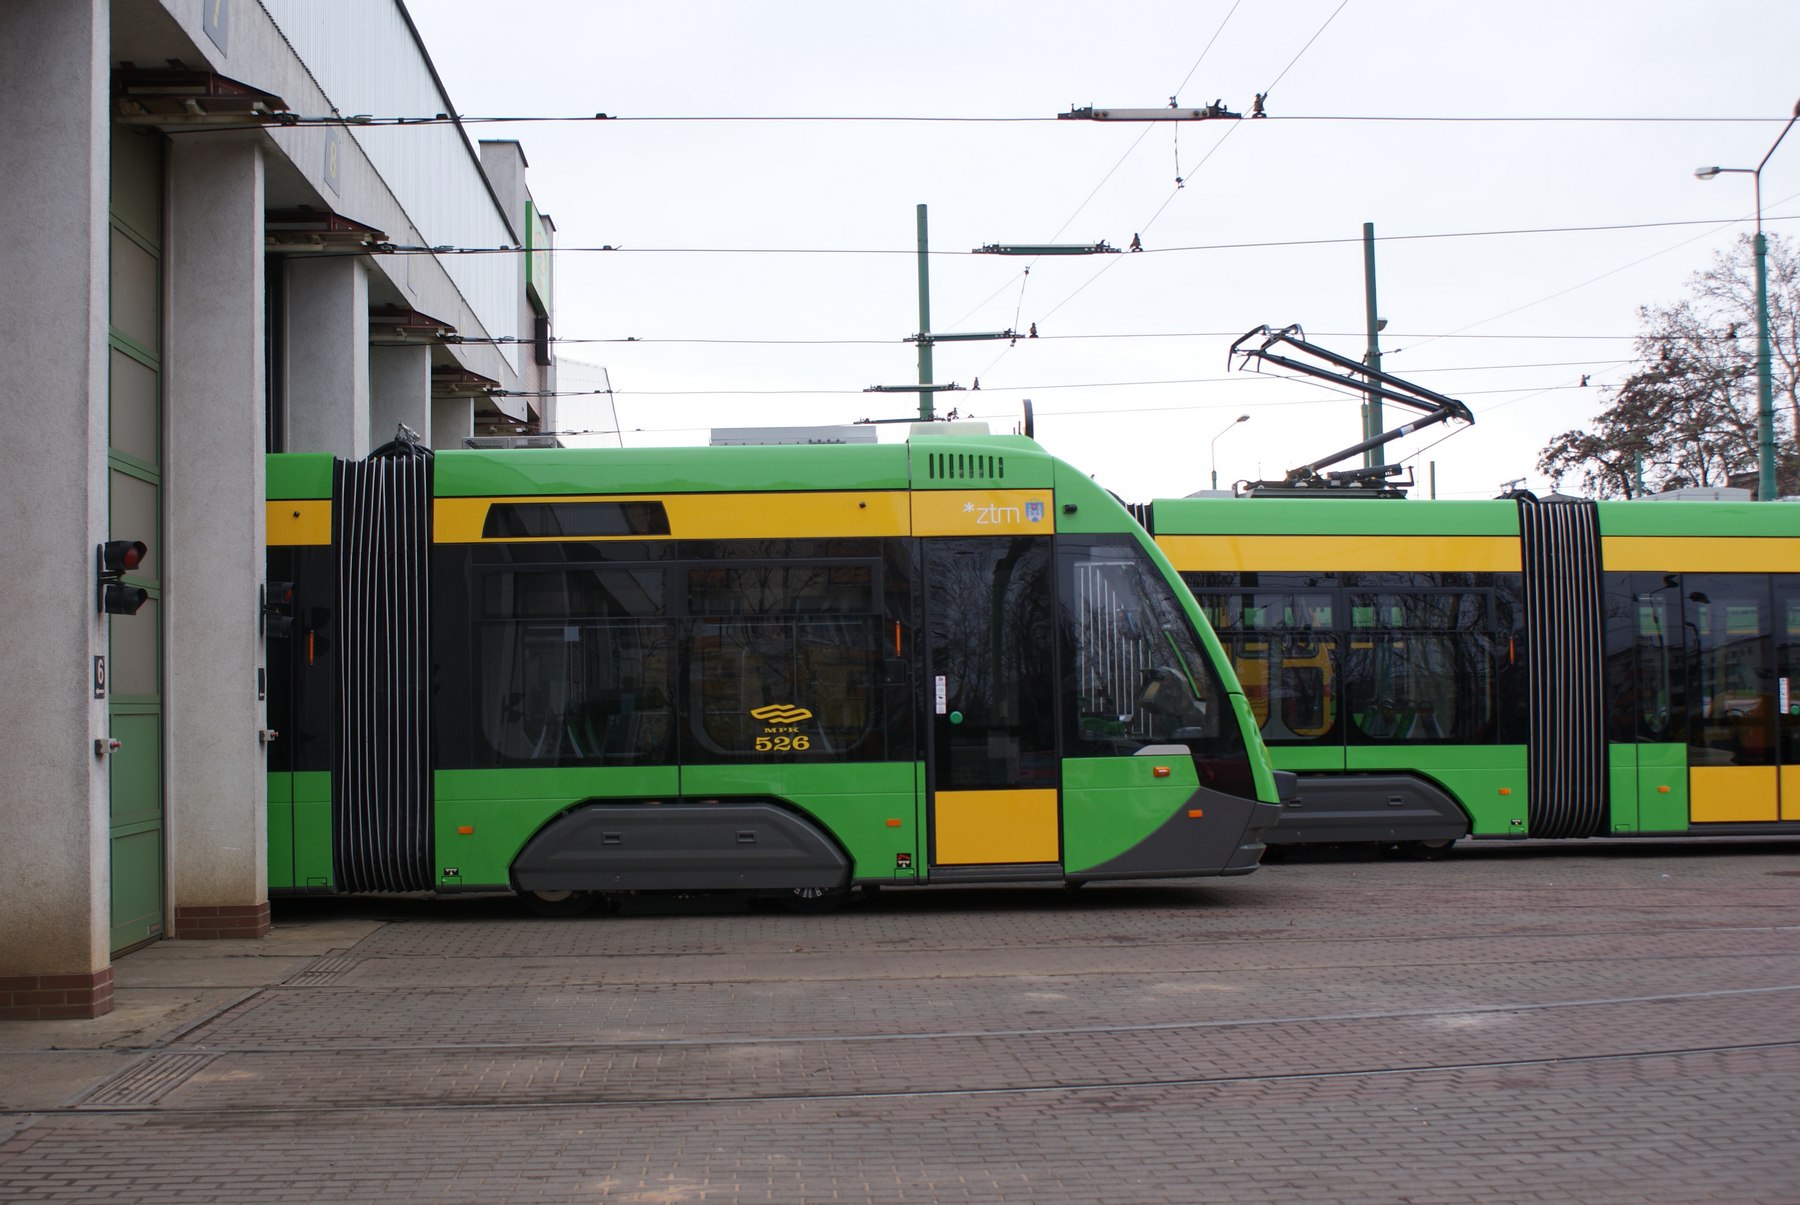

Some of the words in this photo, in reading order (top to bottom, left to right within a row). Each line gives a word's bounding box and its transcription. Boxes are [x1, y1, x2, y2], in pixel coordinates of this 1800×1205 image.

[330, 142, 337, 178] 8
[98, 658, 104, 684] 6
[755, 735, 810, 752] 526
